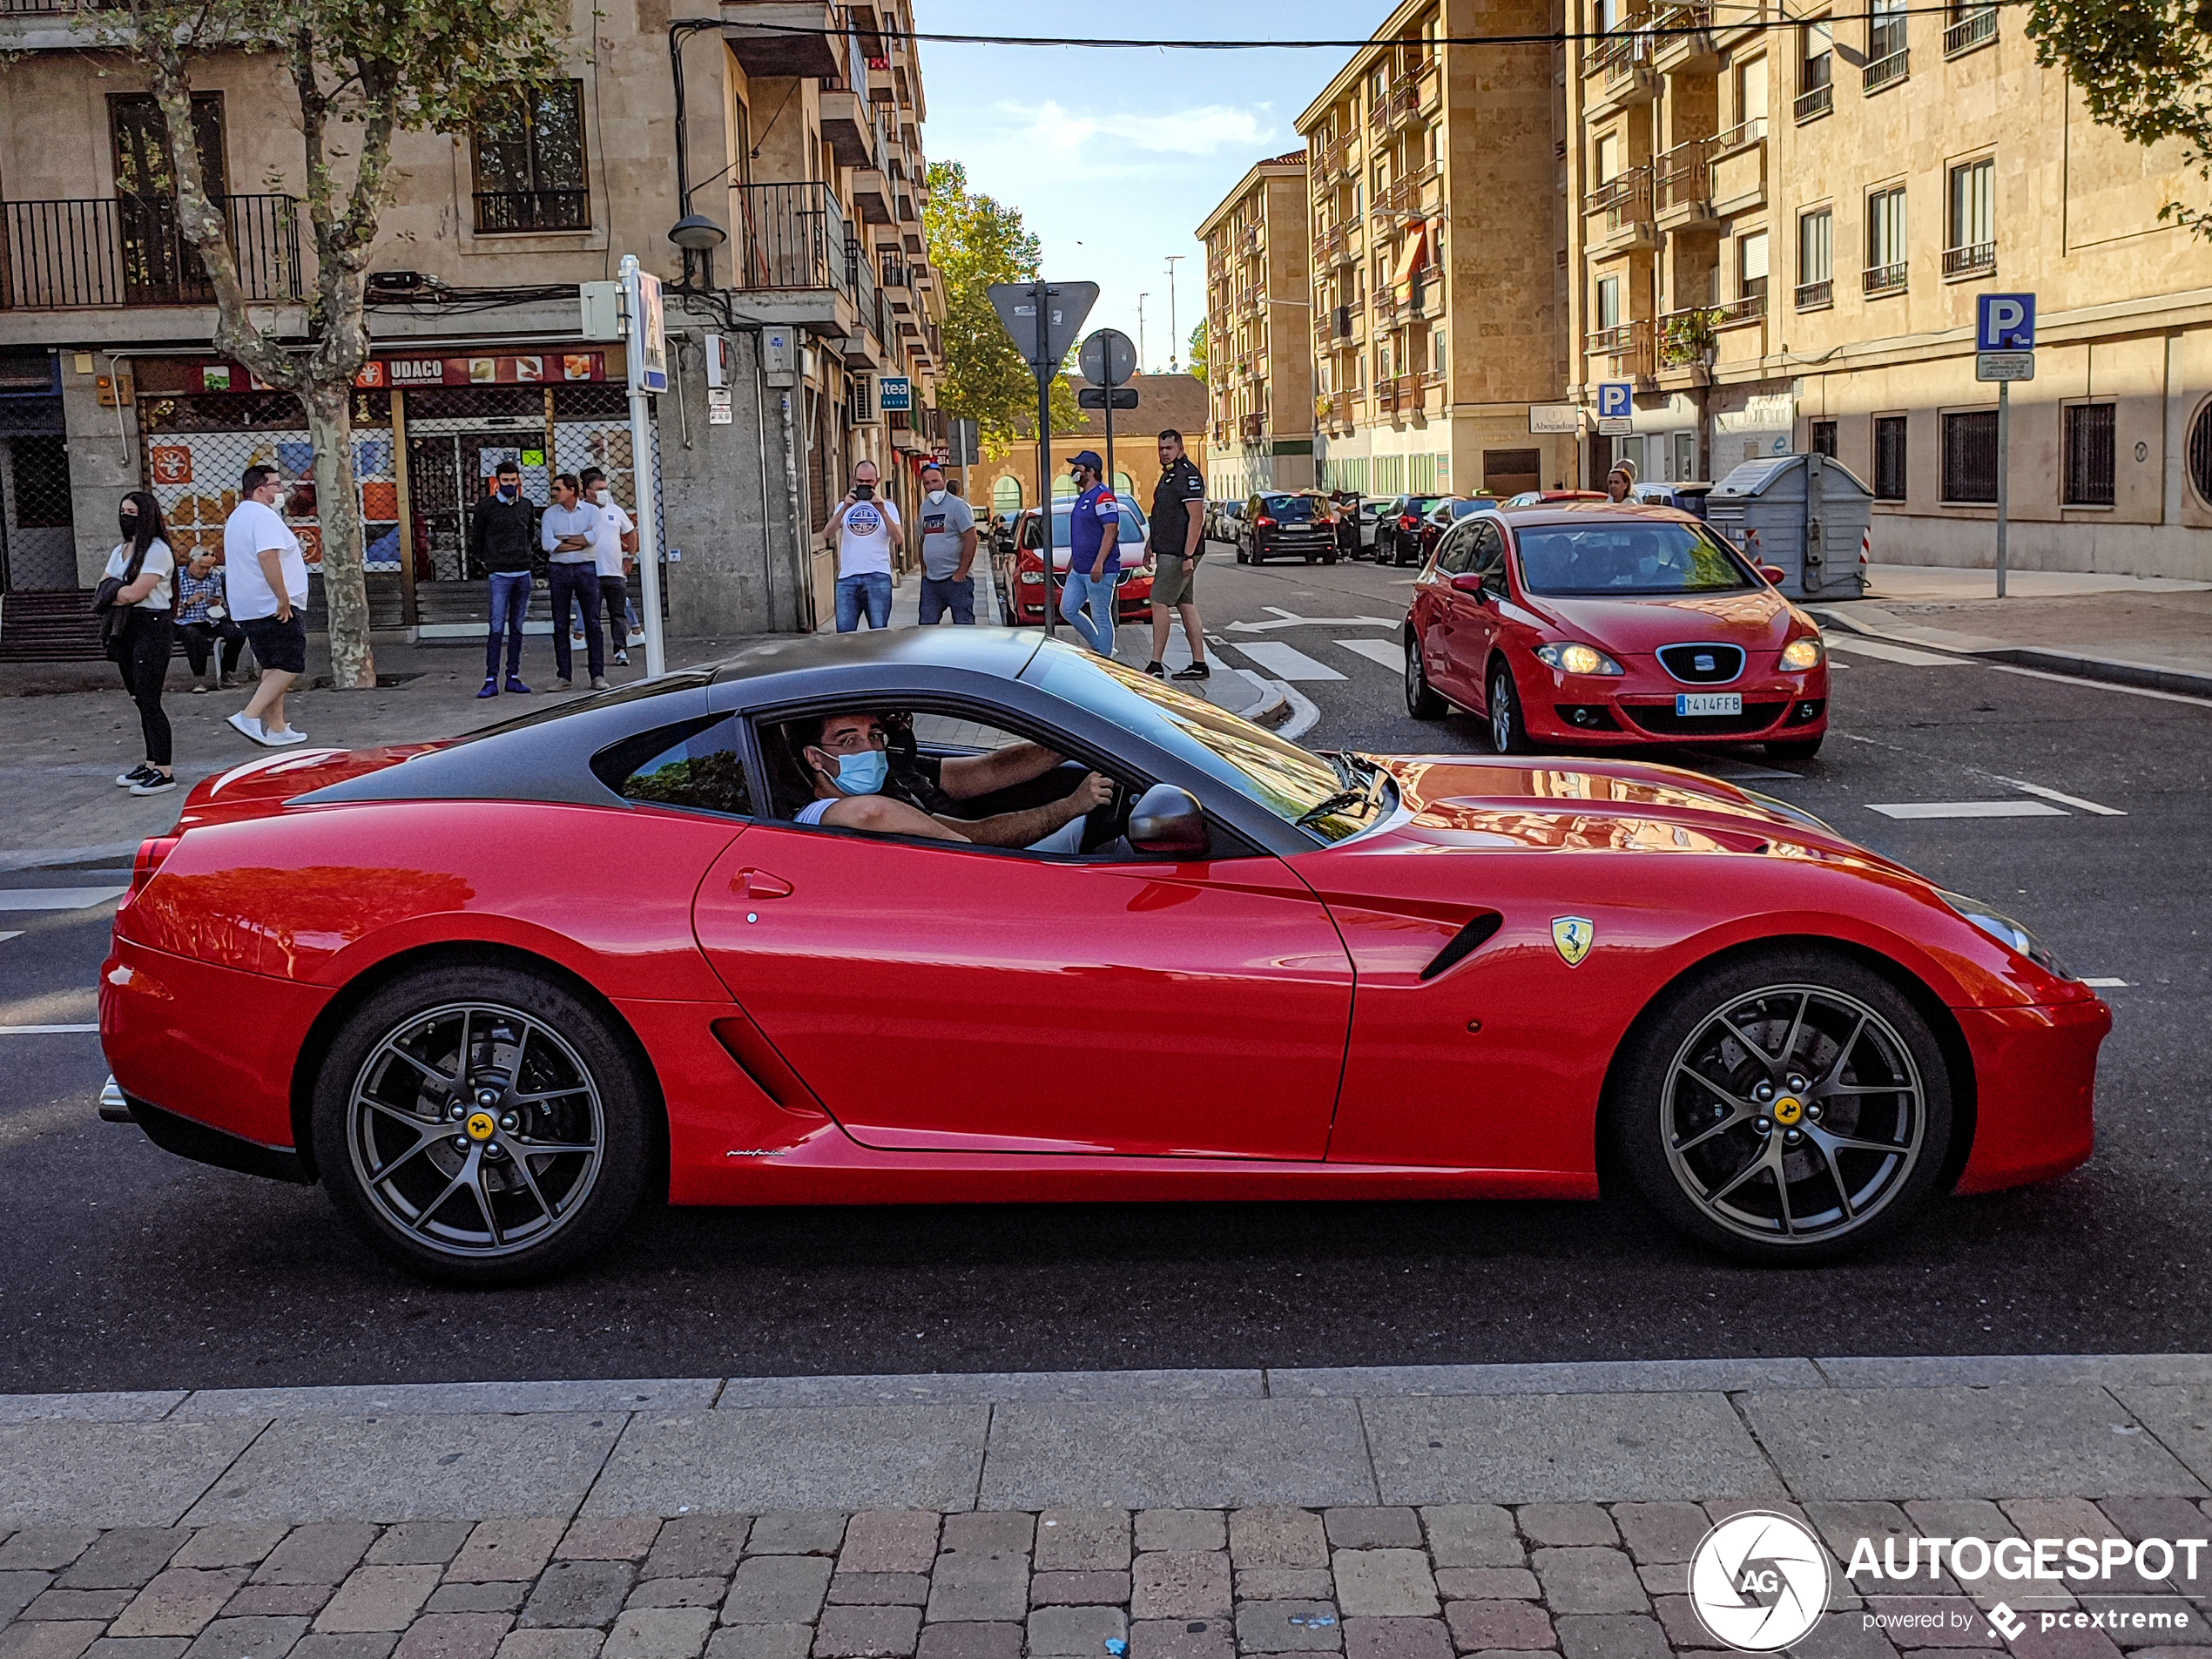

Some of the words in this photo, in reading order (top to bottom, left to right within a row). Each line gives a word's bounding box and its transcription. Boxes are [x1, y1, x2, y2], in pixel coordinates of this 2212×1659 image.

[1987, 300, 2024, 344] P
[391, 360, 442, 378] UDACO
[1603, 387, 1625, 414] P
[1534, 421, 1575, 430] Abogados
[1687, 698, 1740, 711] 1414FFB
